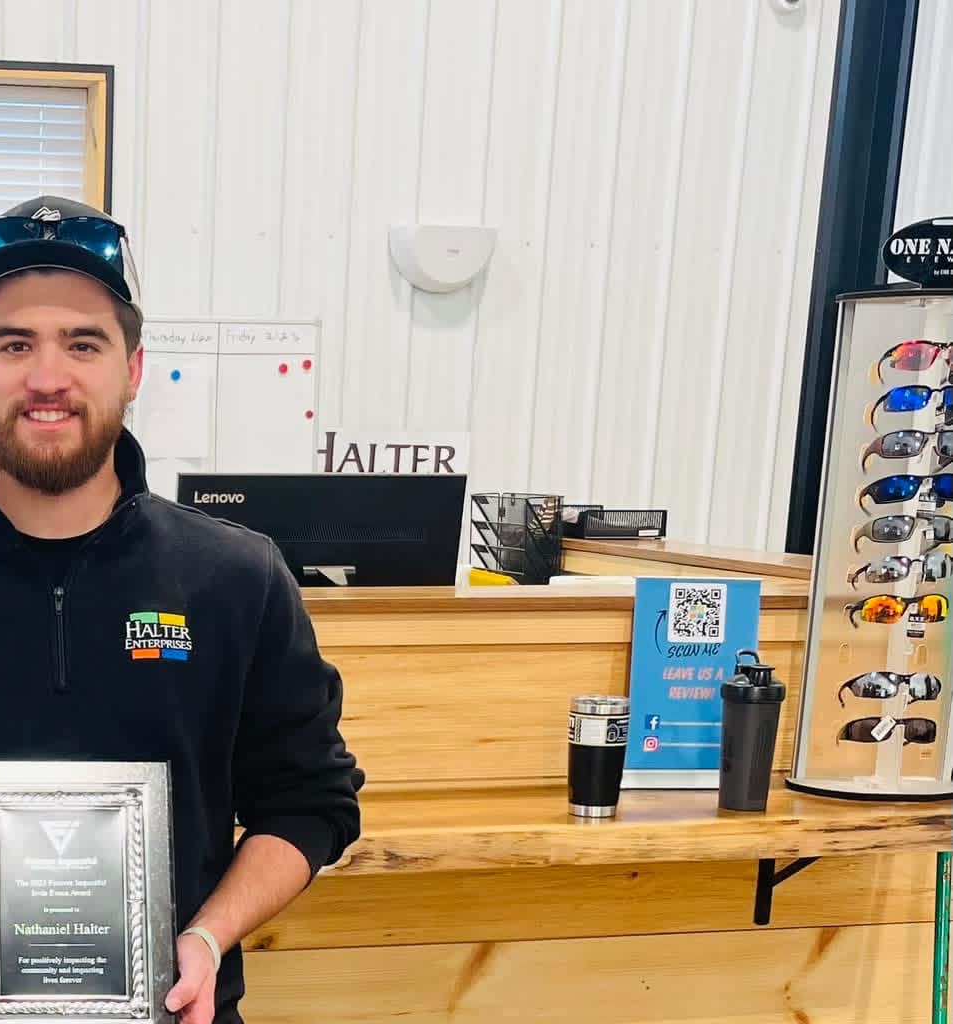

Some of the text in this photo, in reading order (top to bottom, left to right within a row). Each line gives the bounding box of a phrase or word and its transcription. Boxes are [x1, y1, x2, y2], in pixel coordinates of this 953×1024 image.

[890, 238, 953, 255] ONE N
[194, 491, 245, 504] Lenovo
[126, 621, 191, 641] HALTER
[125, 639, 192, 651] ENTERPRISES
[701, 642, 721, 657] ME
[663, 666, 695, 680] LEAVE
[714, 667, 724, 680] A
[14, 923, 110, 935] Nathaniel Halter
